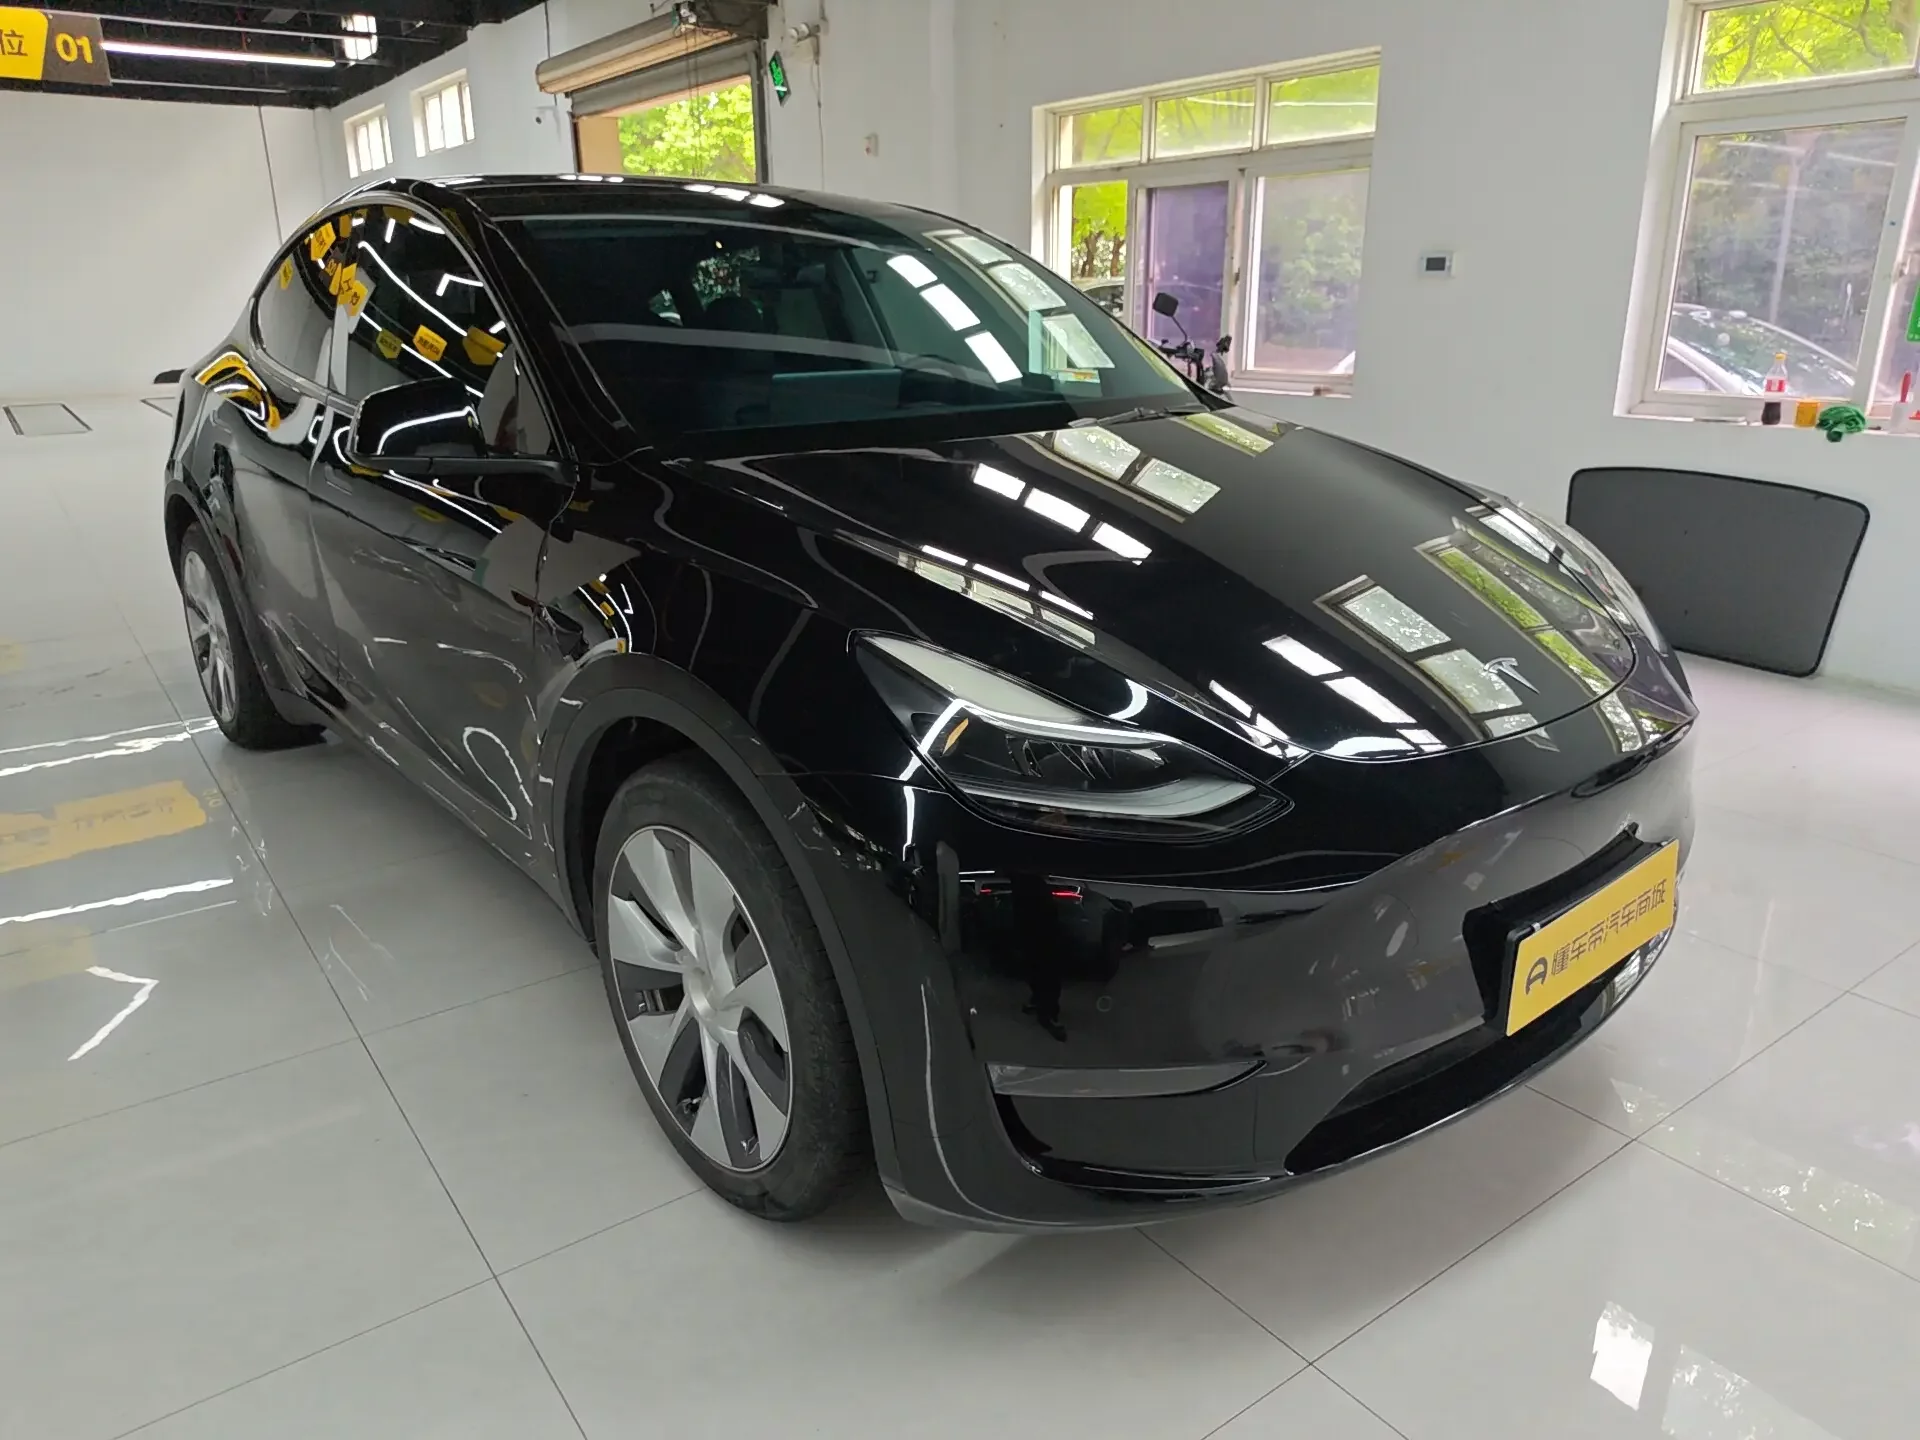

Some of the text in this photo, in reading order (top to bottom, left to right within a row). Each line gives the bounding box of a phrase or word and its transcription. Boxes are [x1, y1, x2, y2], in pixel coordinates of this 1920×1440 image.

[55, 32, 93, 64] 01
[1551, 878, 1667, 976] 懂车帝汽车商城
